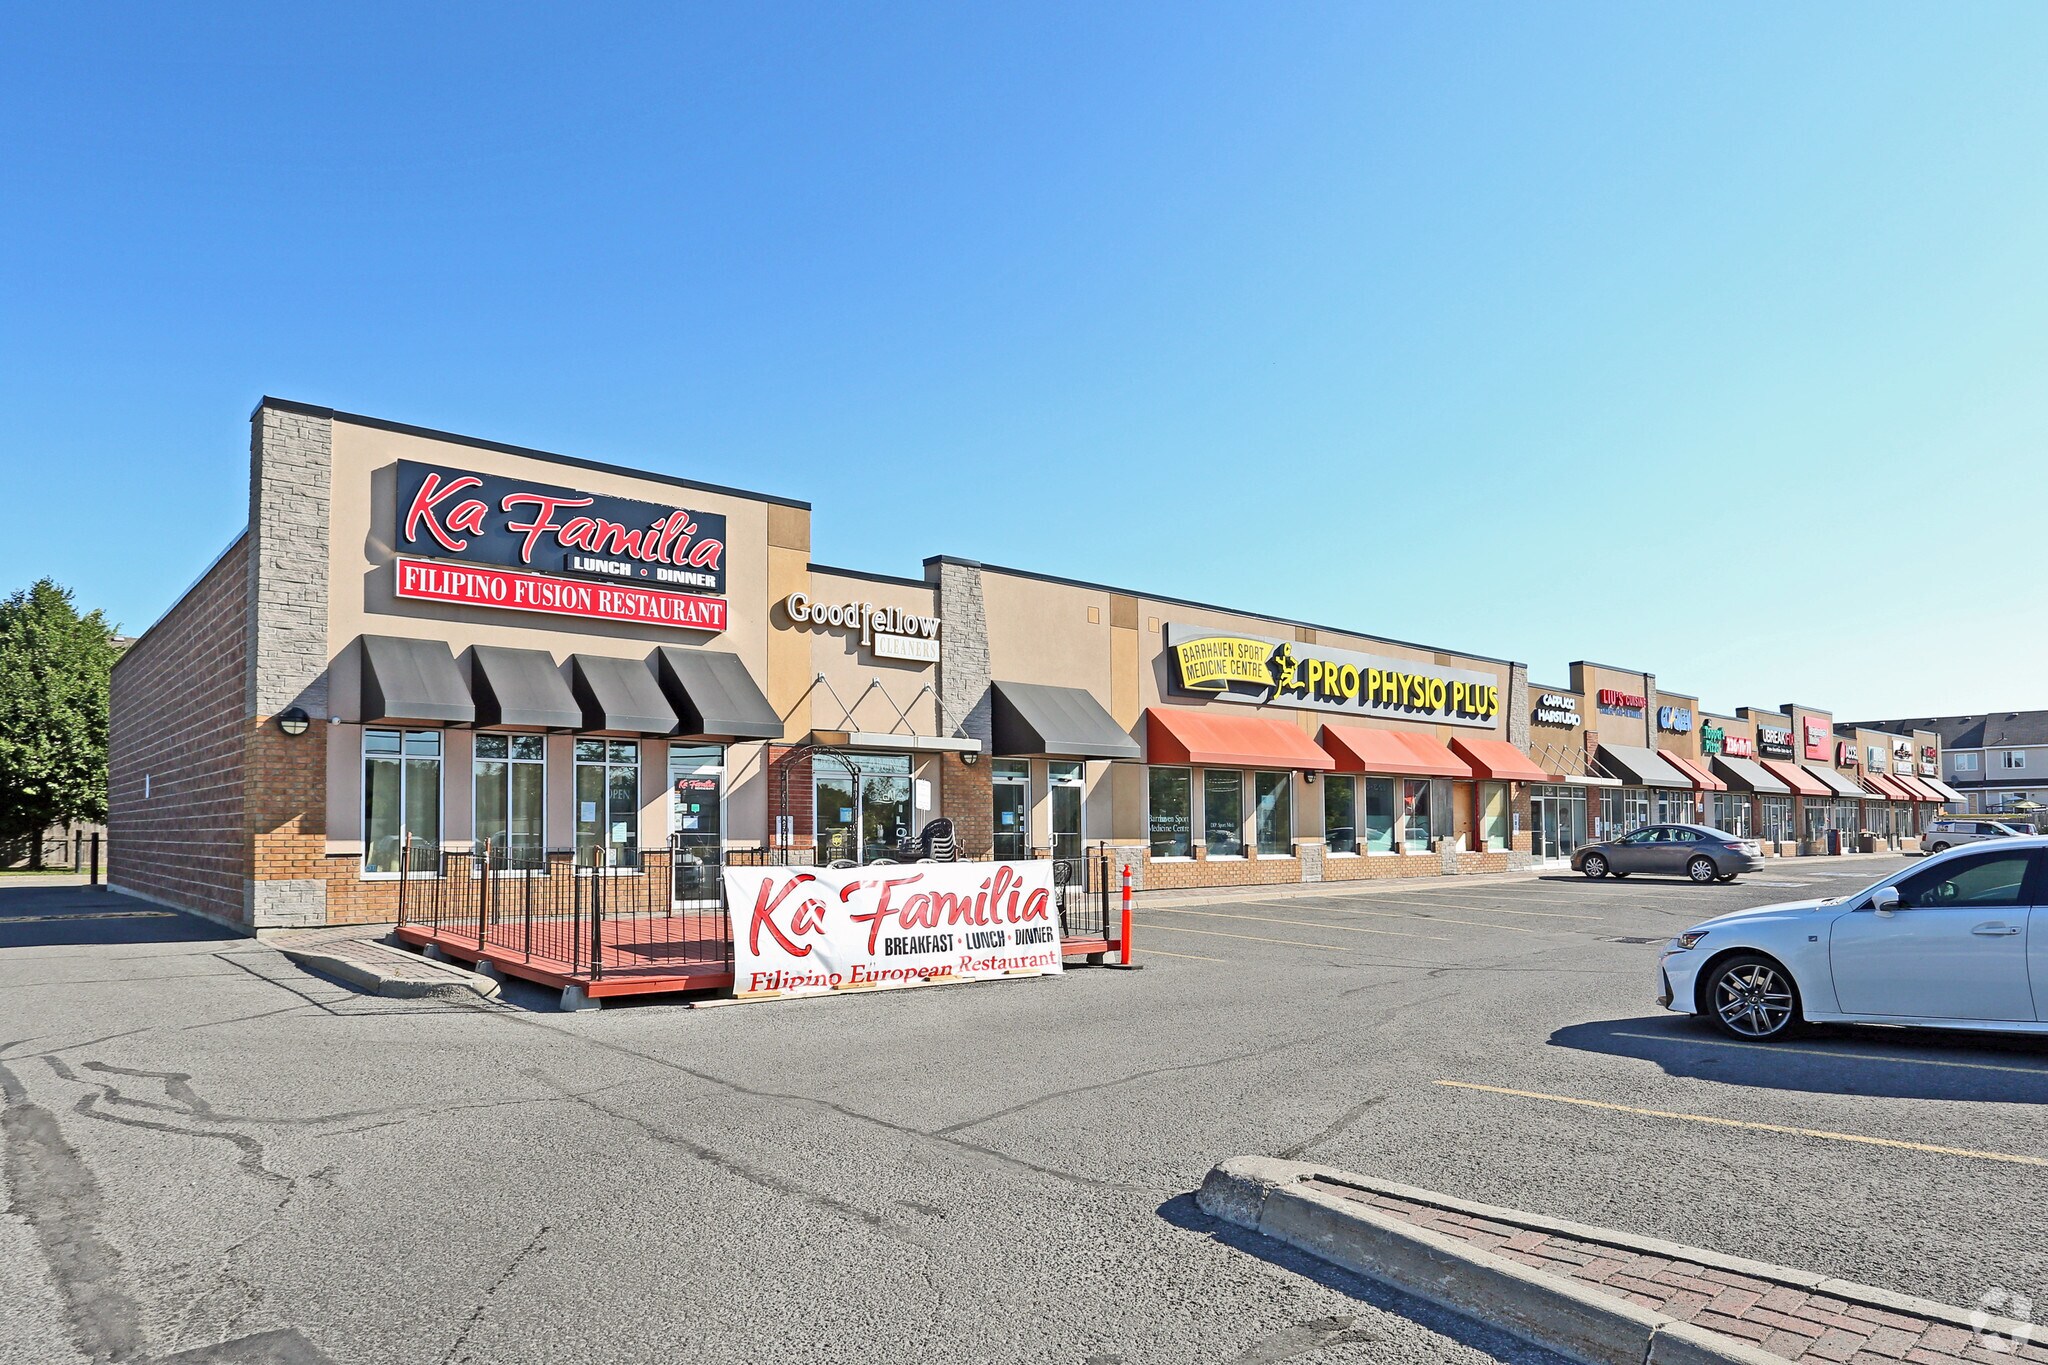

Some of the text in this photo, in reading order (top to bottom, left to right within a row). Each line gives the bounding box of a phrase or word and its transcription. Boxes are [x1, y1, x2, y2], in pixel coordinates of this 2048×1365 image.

[405, 472, 725, 571] Ka Familia
[574, 557, 717, 588] LUNCH DINNER
[404, 566, 723, 624] FILIPINO FUSION RESTAURANT
[787, 592, 941, 646] Goodfellow
[879, 637, 936, 659] CLEANERS
[1182, 642, 1264, 664] BARRHAVEN SPORT
[1186, 659, 1262, 681] MEDICINE CENTRE
[1308, 658, 1499, 717] PRO PHYSIO PLUS
[1603, 690, 1646, 709] LIU'S CUISINE
[752, 865, 1049, 957] Ka Familia
[884, 926, 1055, 957] BREAKFAST LUNCH DINNER
[749, 949, 1058, 993] Filipino European Restaurant
